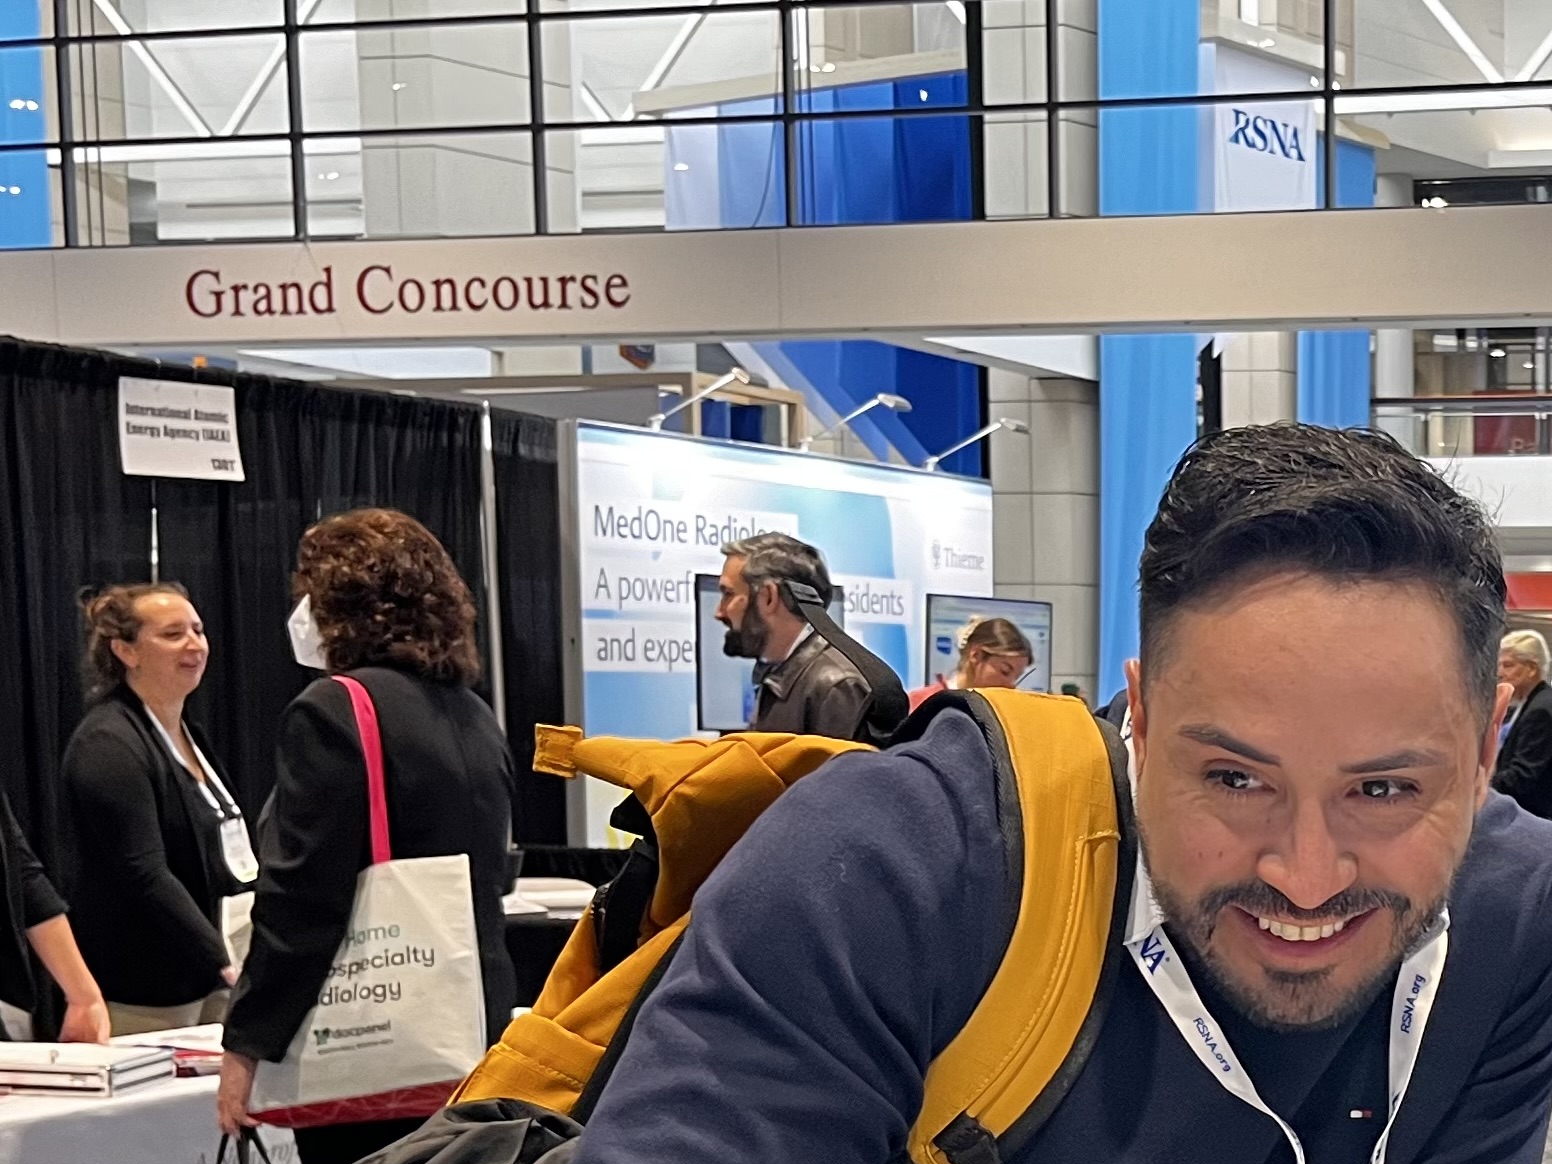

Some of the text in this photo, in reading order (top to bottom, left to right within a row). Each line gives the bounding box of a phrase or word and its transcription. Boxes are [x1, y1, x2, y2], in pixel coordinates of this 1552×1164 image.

[1229, 108, 1305, 162] RSNA
[185, 264, 631, 318] Grand Concourse
[593, 505, 687, 544] MedOne
[594, 567, 611, 600] A
[597, 629, 636, 663] and
[320, 981, 401, 1006] diology
[1400, 973, 1426, 1034] RSNA.org
[1193, 1016, 1232, 1072] RSNA.org
